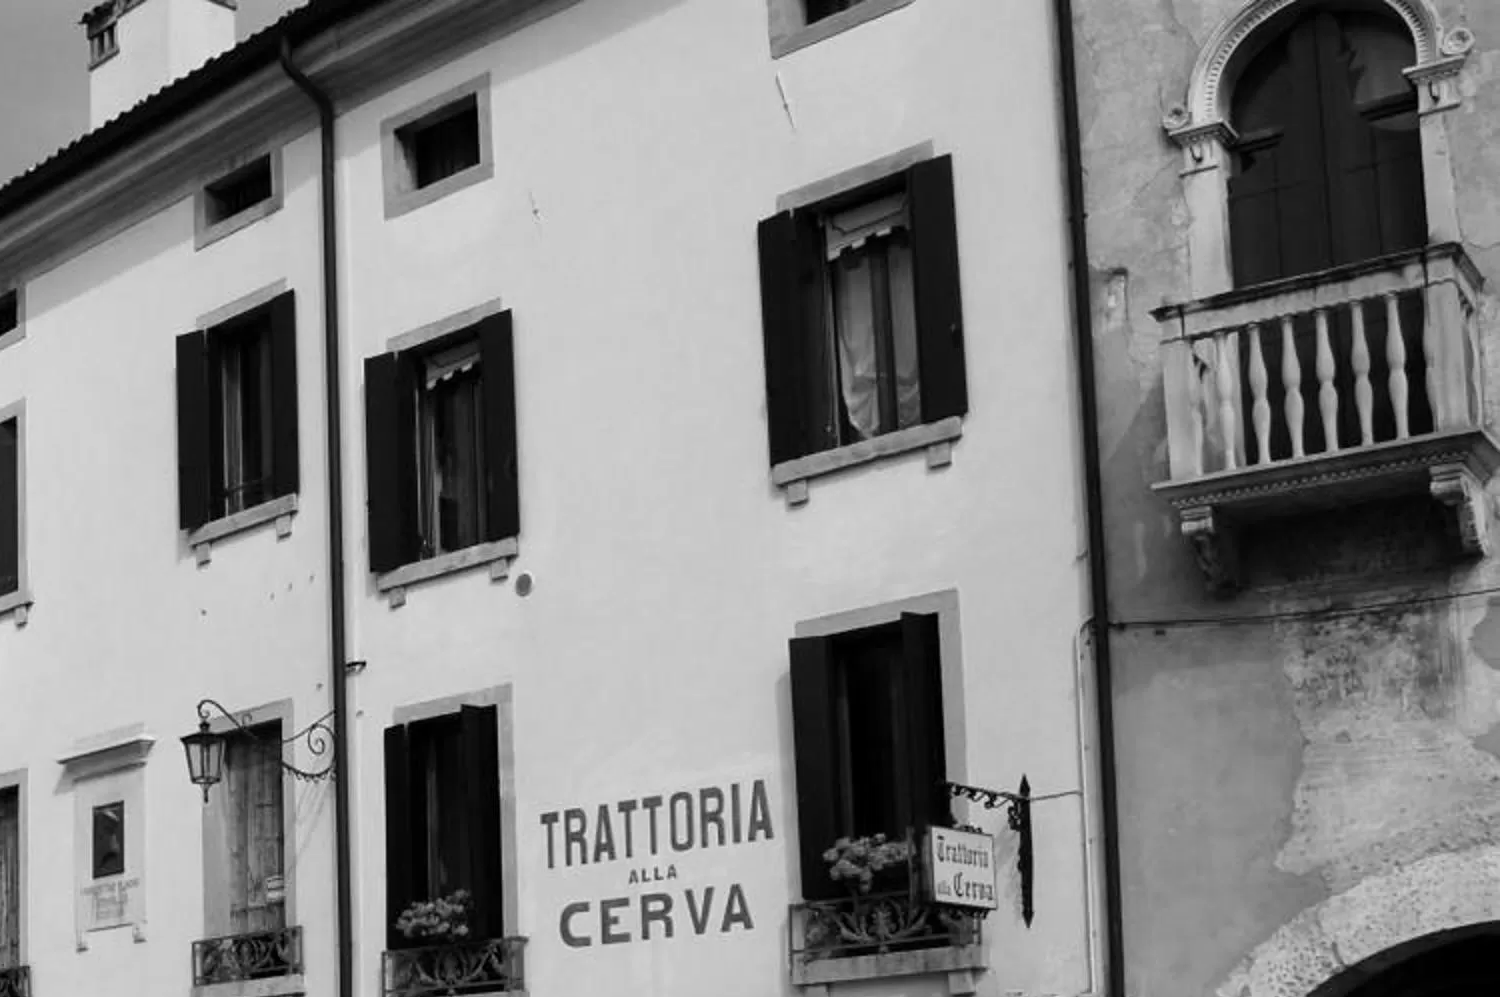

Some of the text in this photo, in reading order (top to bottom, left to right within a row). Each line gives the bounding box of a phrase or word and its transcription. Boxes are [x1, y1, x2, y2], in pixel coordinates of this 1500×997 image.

[540, 779, 774, 869] TRATTORIA
[937, 835, 989, 868] Trattoria
[628, 864, 677, 884] ALLA
[953, 872, 993, 900] Cerva
[559, 883, 754, 948] CERVA
